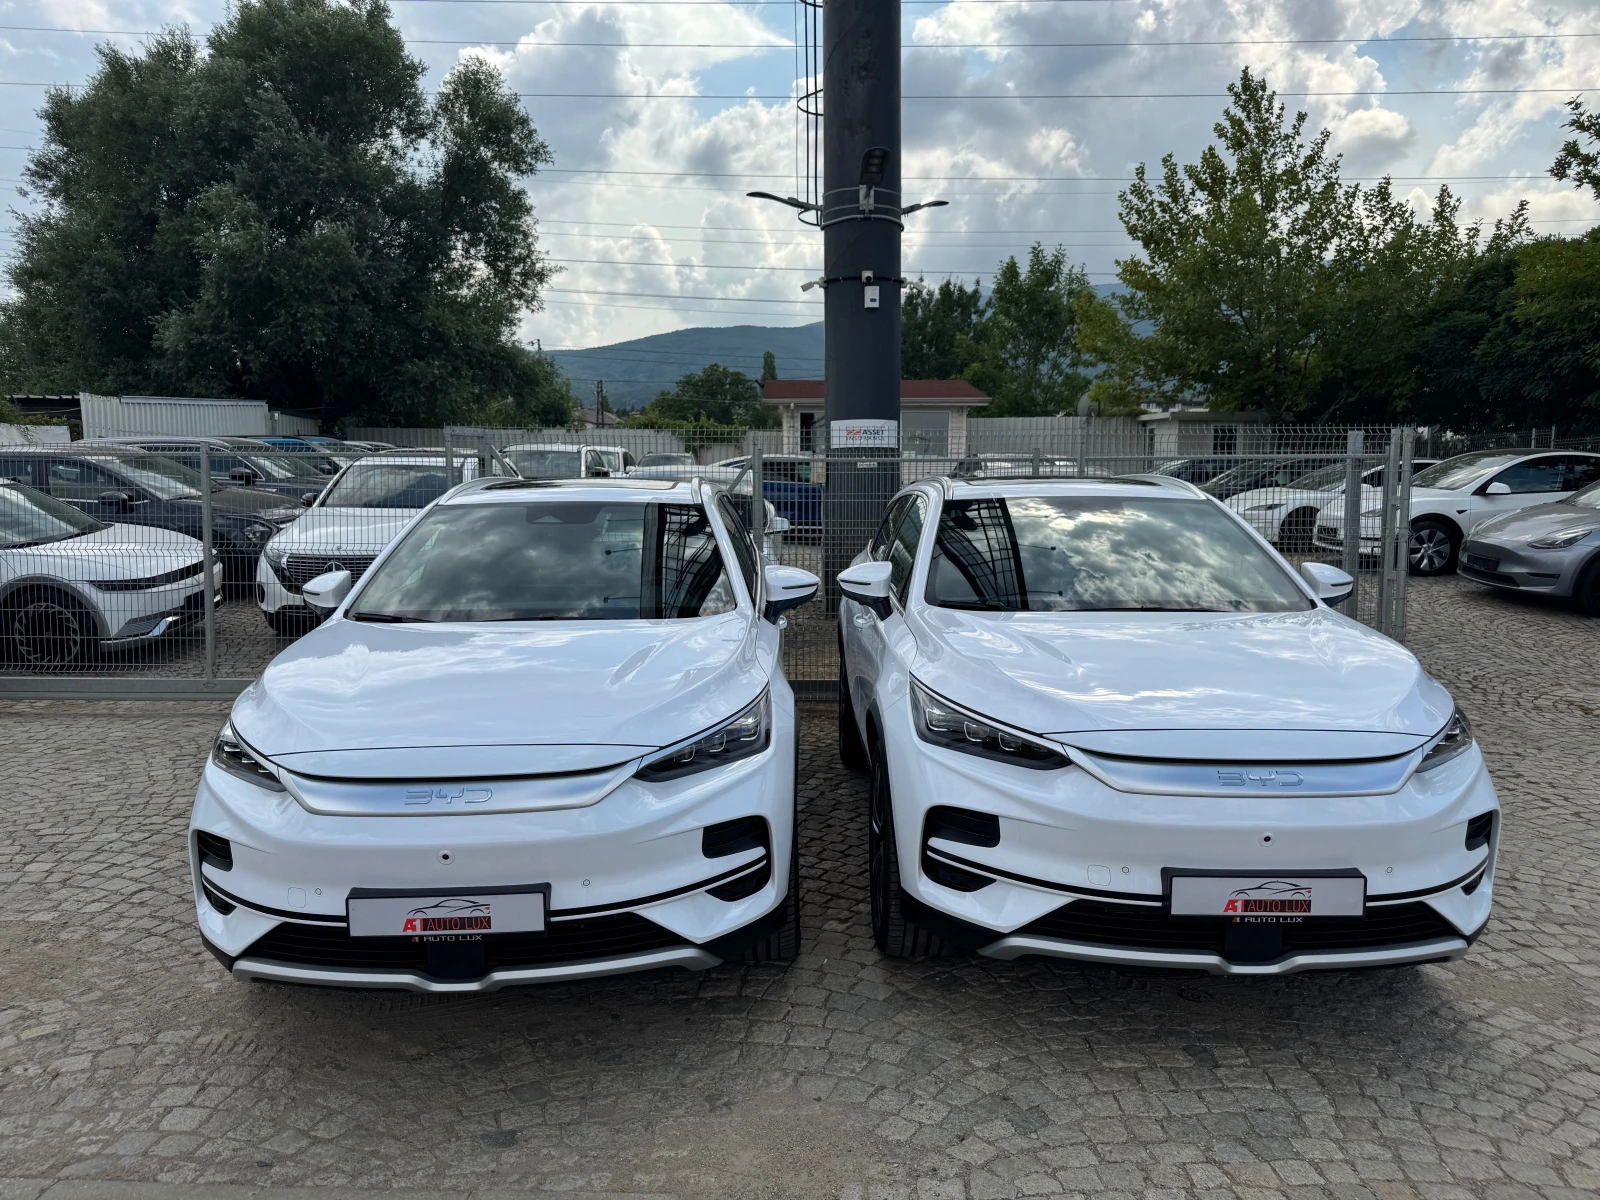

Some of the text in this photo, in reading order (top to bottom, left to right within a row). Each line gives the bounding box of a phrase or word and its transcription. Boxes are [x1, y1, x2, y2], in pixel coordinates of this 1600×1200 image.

[1217, 770, 1304, 786] BYD
[404, 787, 493, 805] BYD
[1223, 899, 1309, 913] A1 AUTO LUX
[402, 916, 490, 932] A1 AUTO LUX
